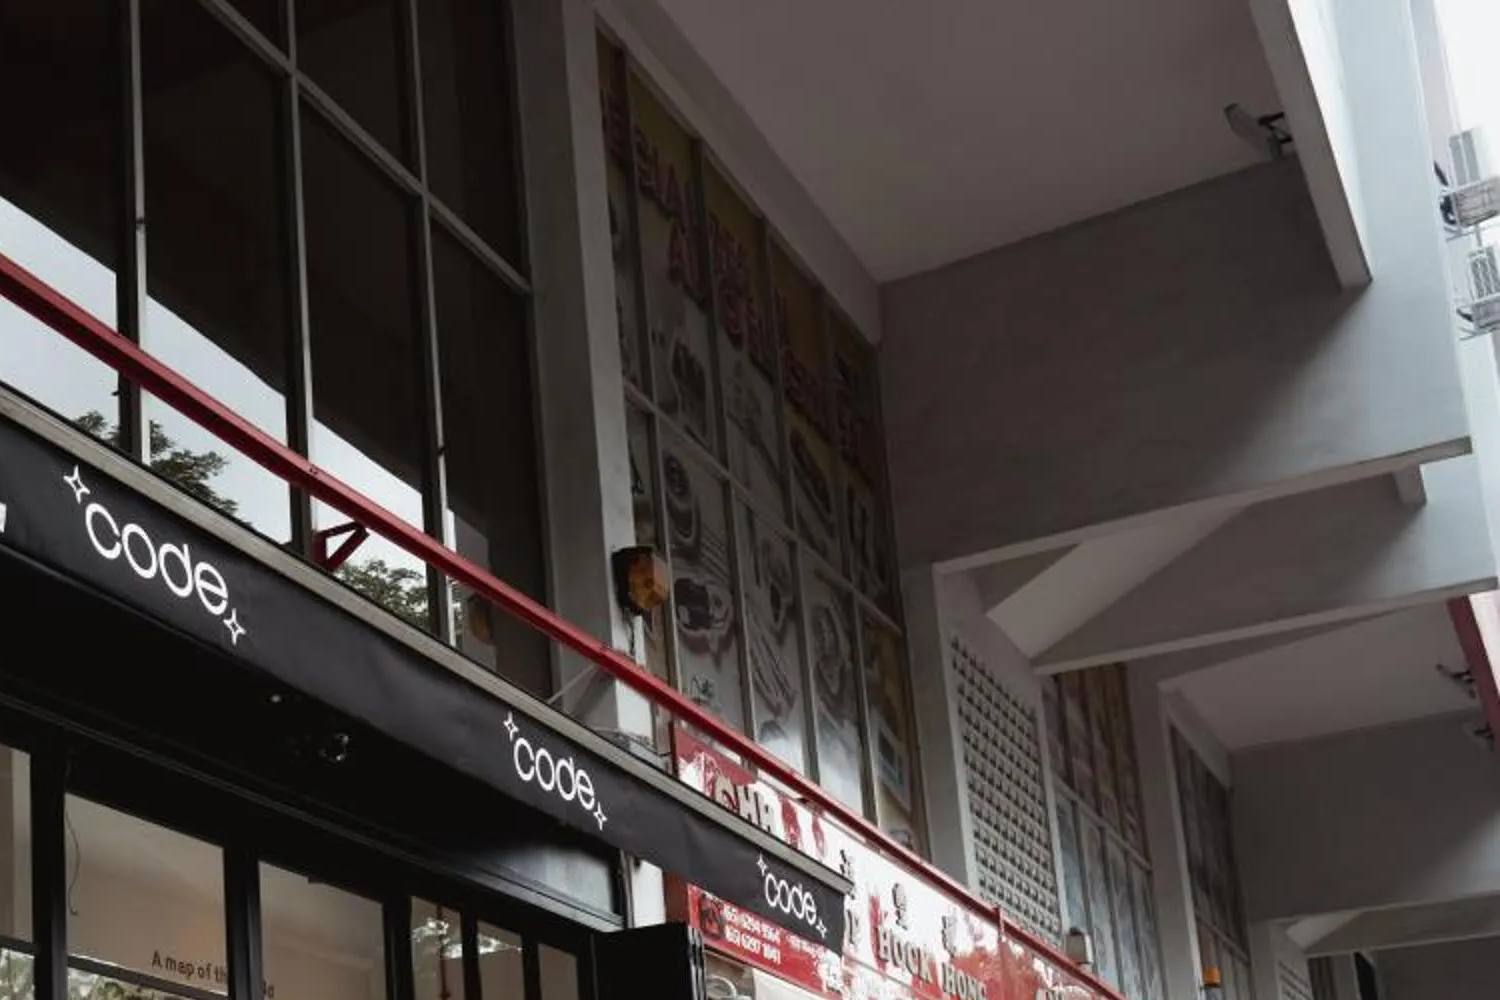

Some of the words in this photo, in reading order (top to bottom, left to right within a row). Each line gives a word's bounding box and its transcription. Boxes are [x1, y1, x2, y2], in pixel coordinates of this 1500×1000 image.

[85, 502, 229, 616] code
[514, 737, 595, 811] code
[765, 873, 817, 926] code
[151, 950, 163, 968] A
[165, 957, 195, 979] map
[197, 962, 212, 979] of
